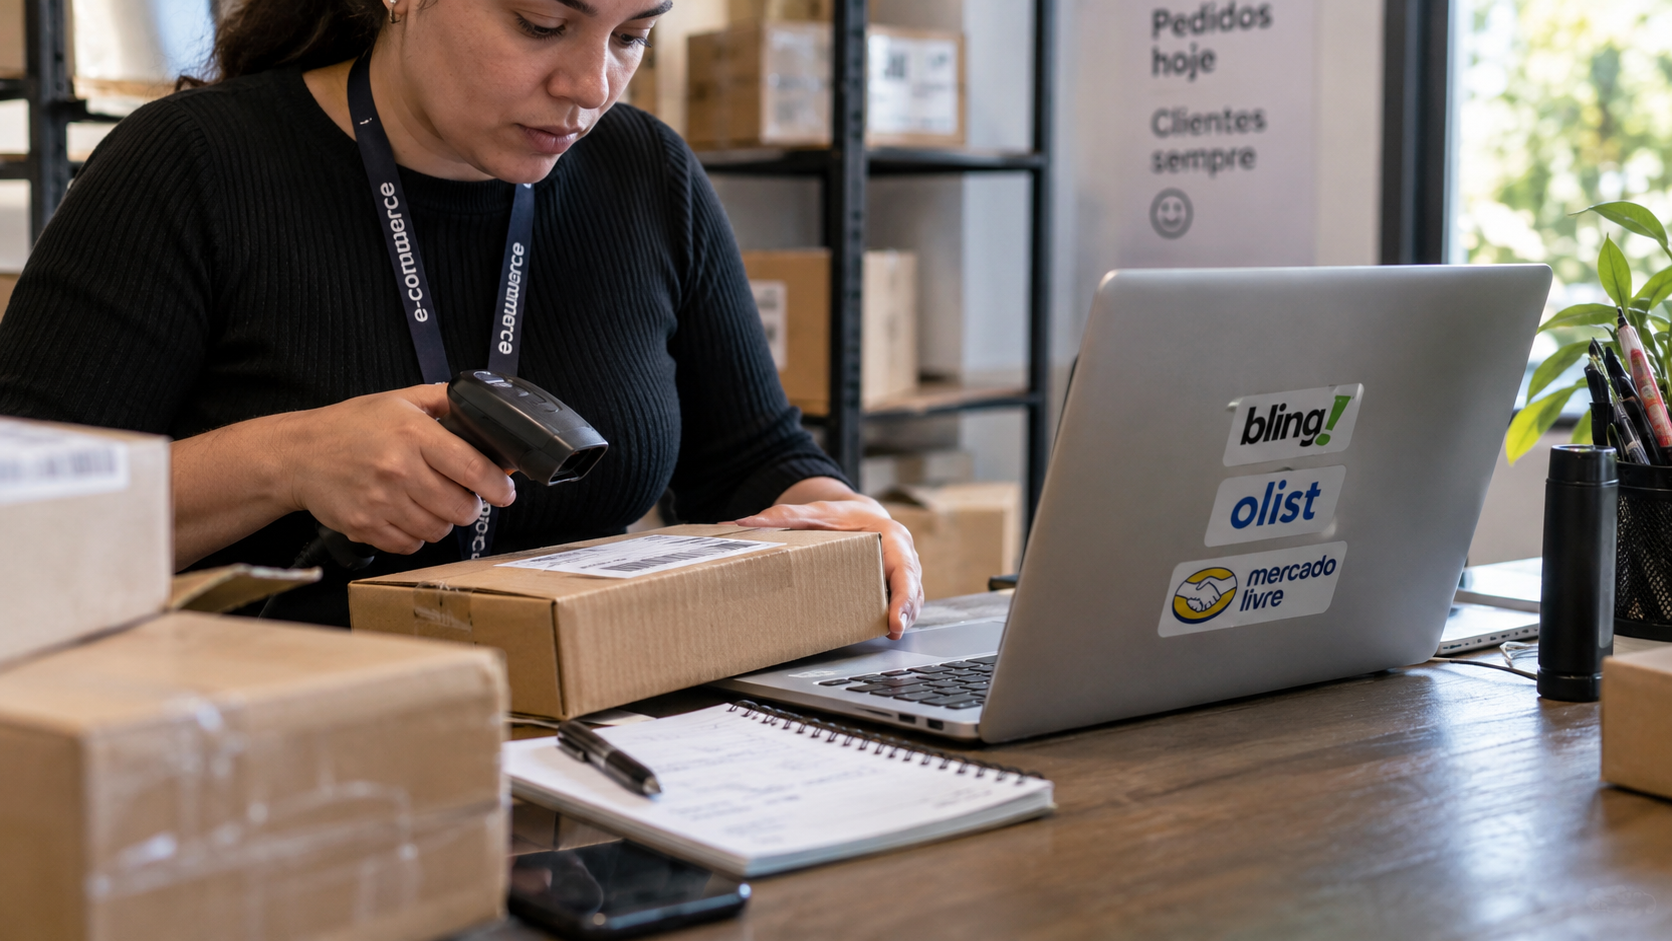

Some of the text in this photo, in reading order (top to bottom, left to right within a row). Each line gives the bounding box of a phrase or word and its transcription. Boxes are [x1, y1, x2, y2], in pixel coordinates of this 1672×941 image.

[1152, 1, 1273, 40] Pedidos
[1152, 42, 1216, 82] hoje
[1151, 106, 1267, 139] Clientes
[1151, 147, 1256, 179] sempre
[380, 181, 428, 322] e-commerce
[1240, 395, 1351, 447] bling!
[1230, 479, 1321, 529] olist
[1247, 555, 1336, 586] mercado
[1239, 589, 1284, 612] livre
